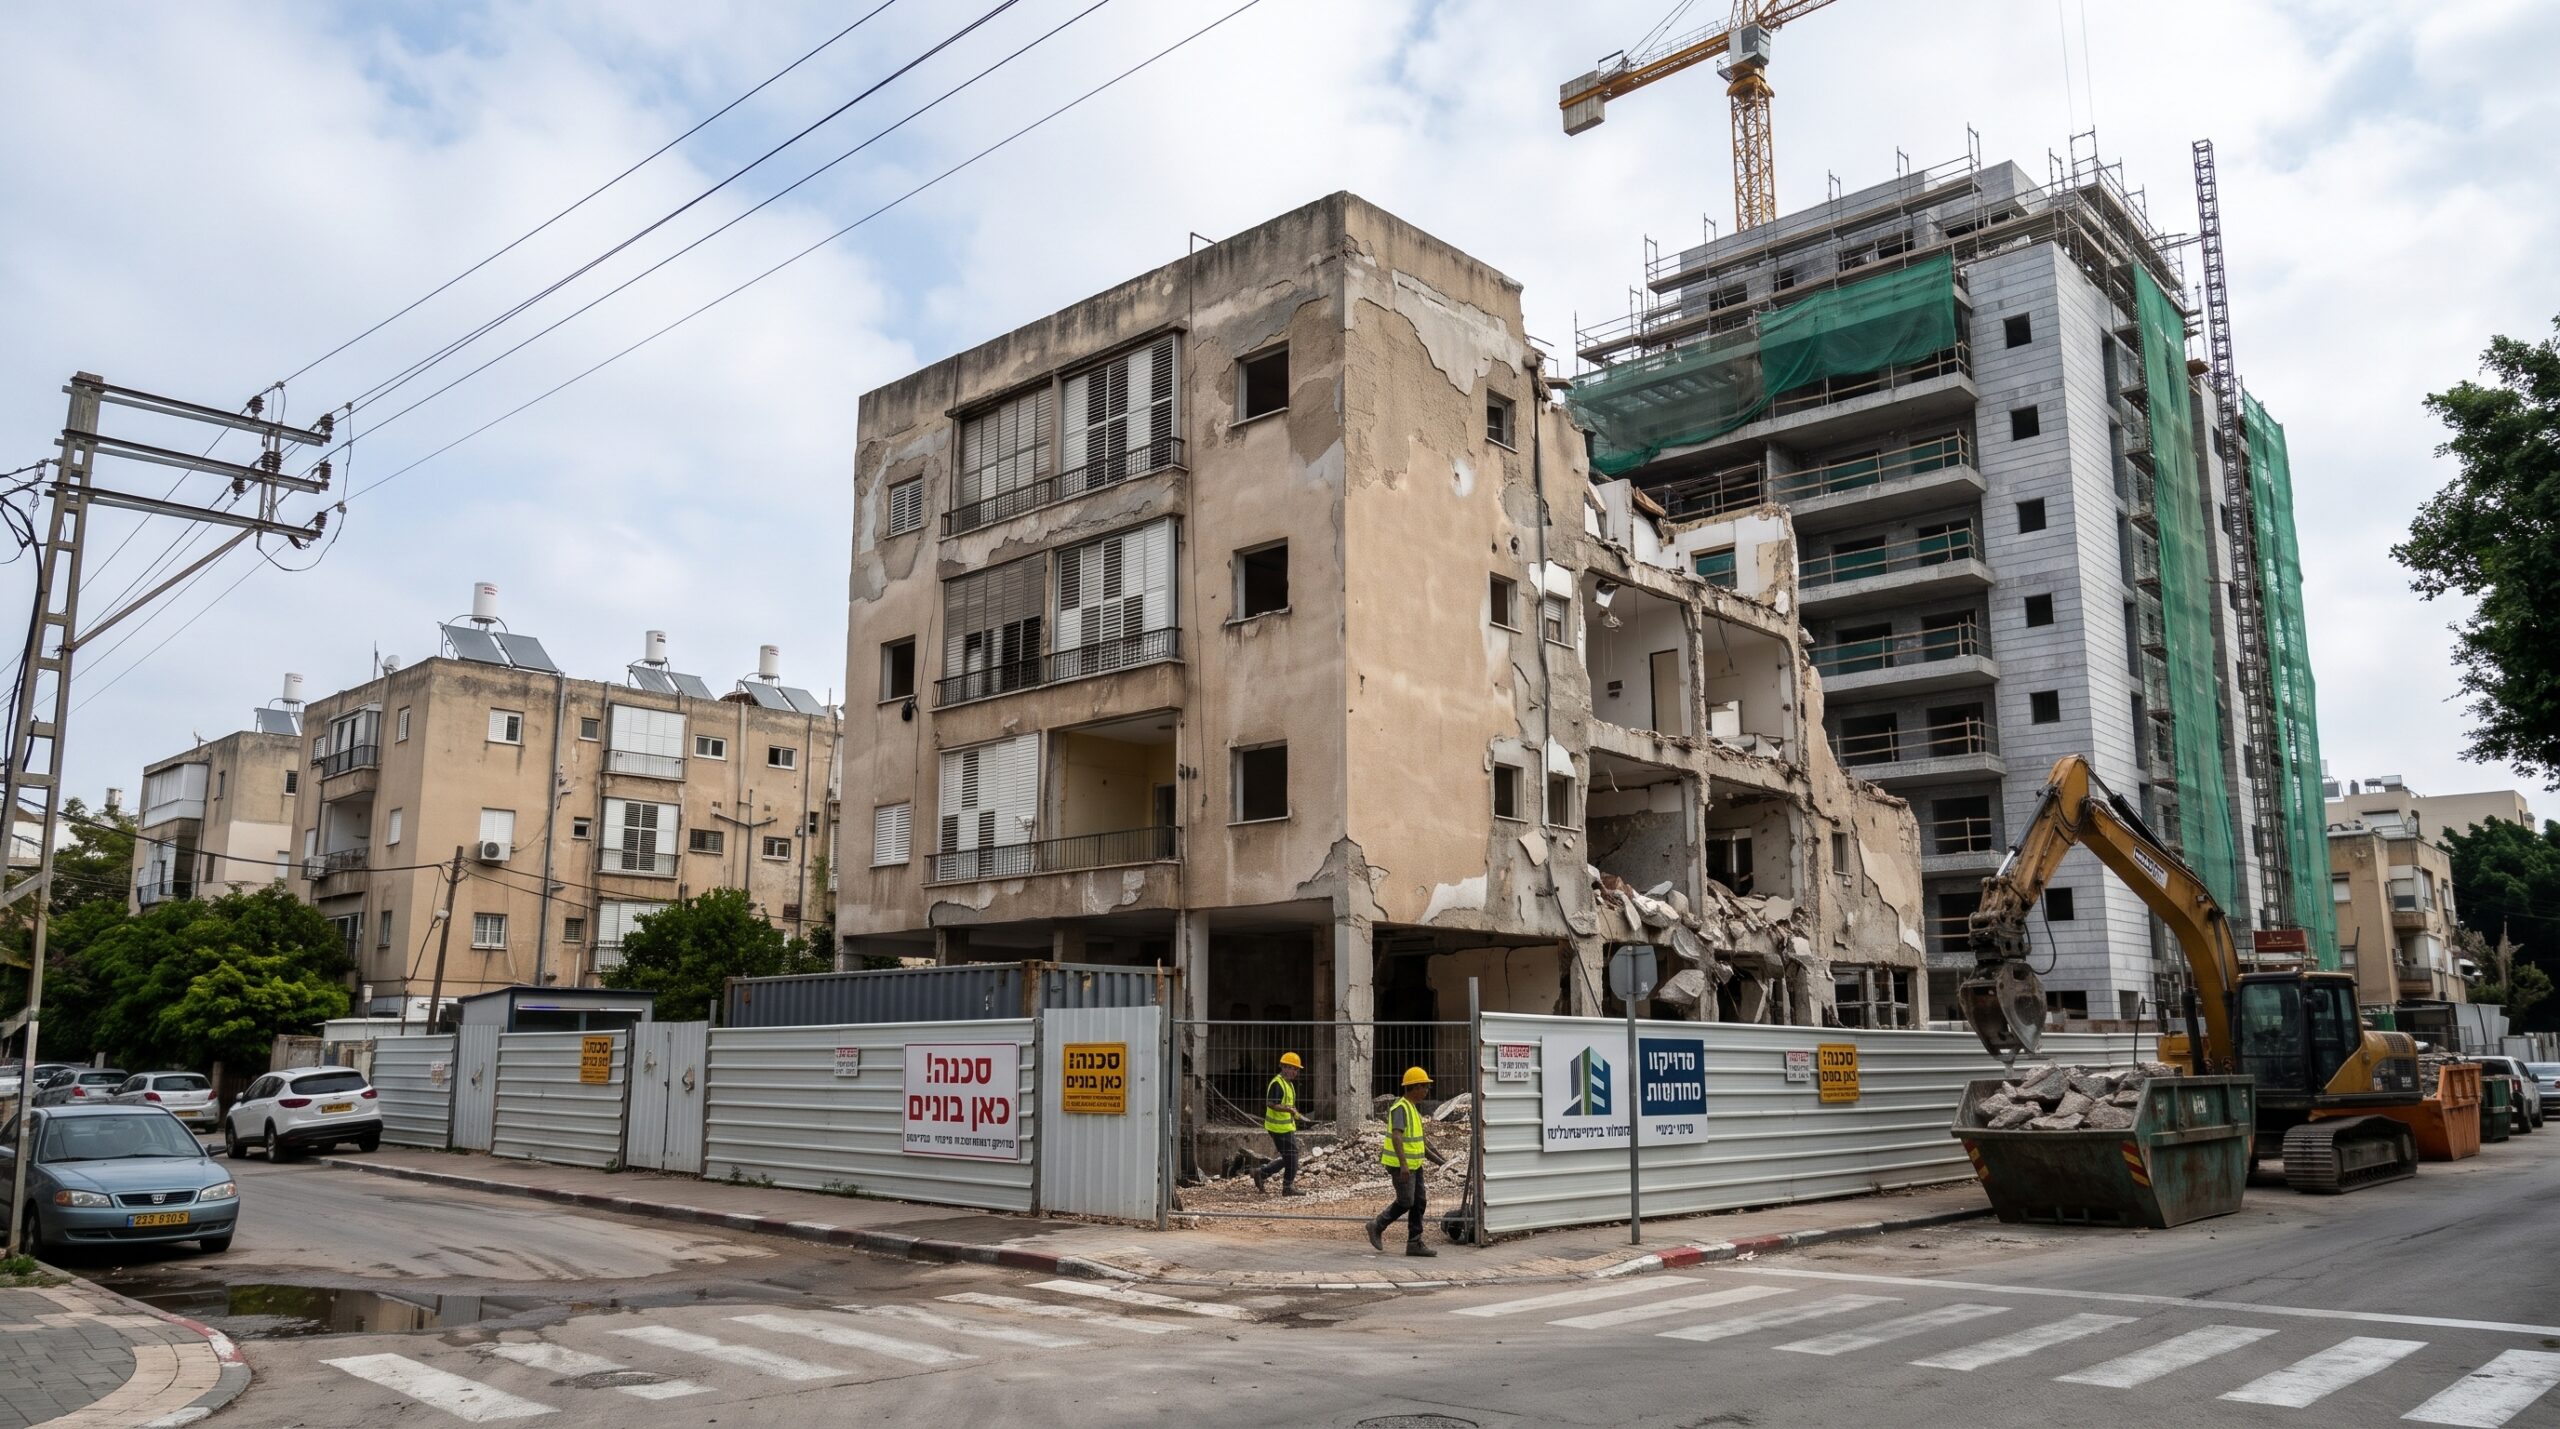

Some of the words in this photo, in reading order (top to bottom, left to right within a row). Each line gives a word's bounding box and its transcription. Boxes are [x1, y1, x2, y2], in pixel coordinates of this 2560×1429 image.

[926, 1052, 992, 1085] סכנה!
[1066, 1075, 1098, 1089] בונים
[1100, 1075, 1122, 1093] כאן
[908, 1094, 965, 1123] בונים
[971, 1096, 1010, 1132] כאן
